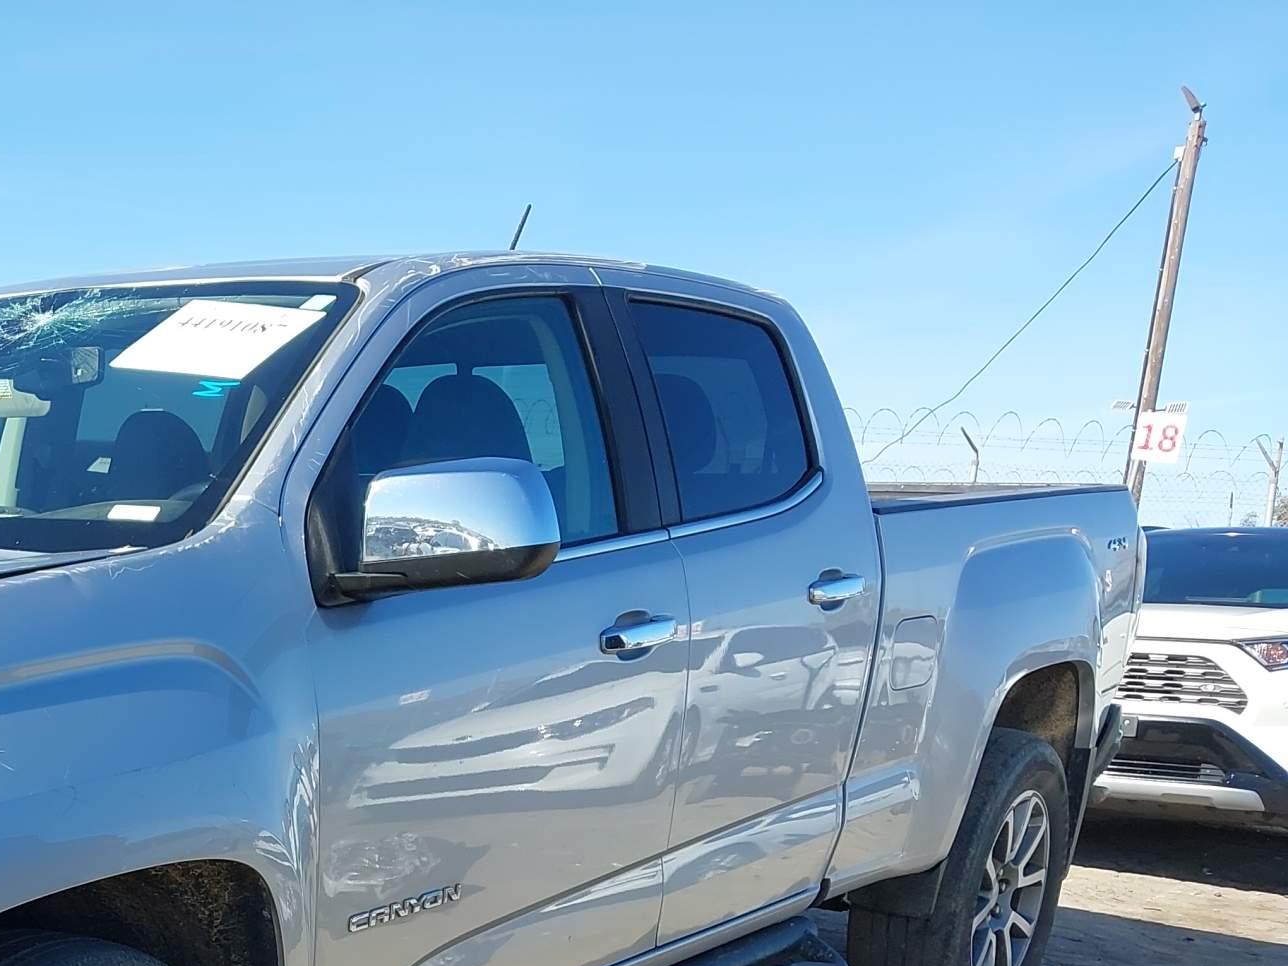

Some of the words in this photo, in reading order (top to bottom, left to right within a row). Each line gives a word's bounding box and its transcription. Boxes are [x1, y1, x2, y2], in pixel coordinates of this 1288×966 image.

[177, 315, 289, 335] 4419108
[1136, 423, 1180, 453] 18
[348, 883, 462, 933] CANYON
